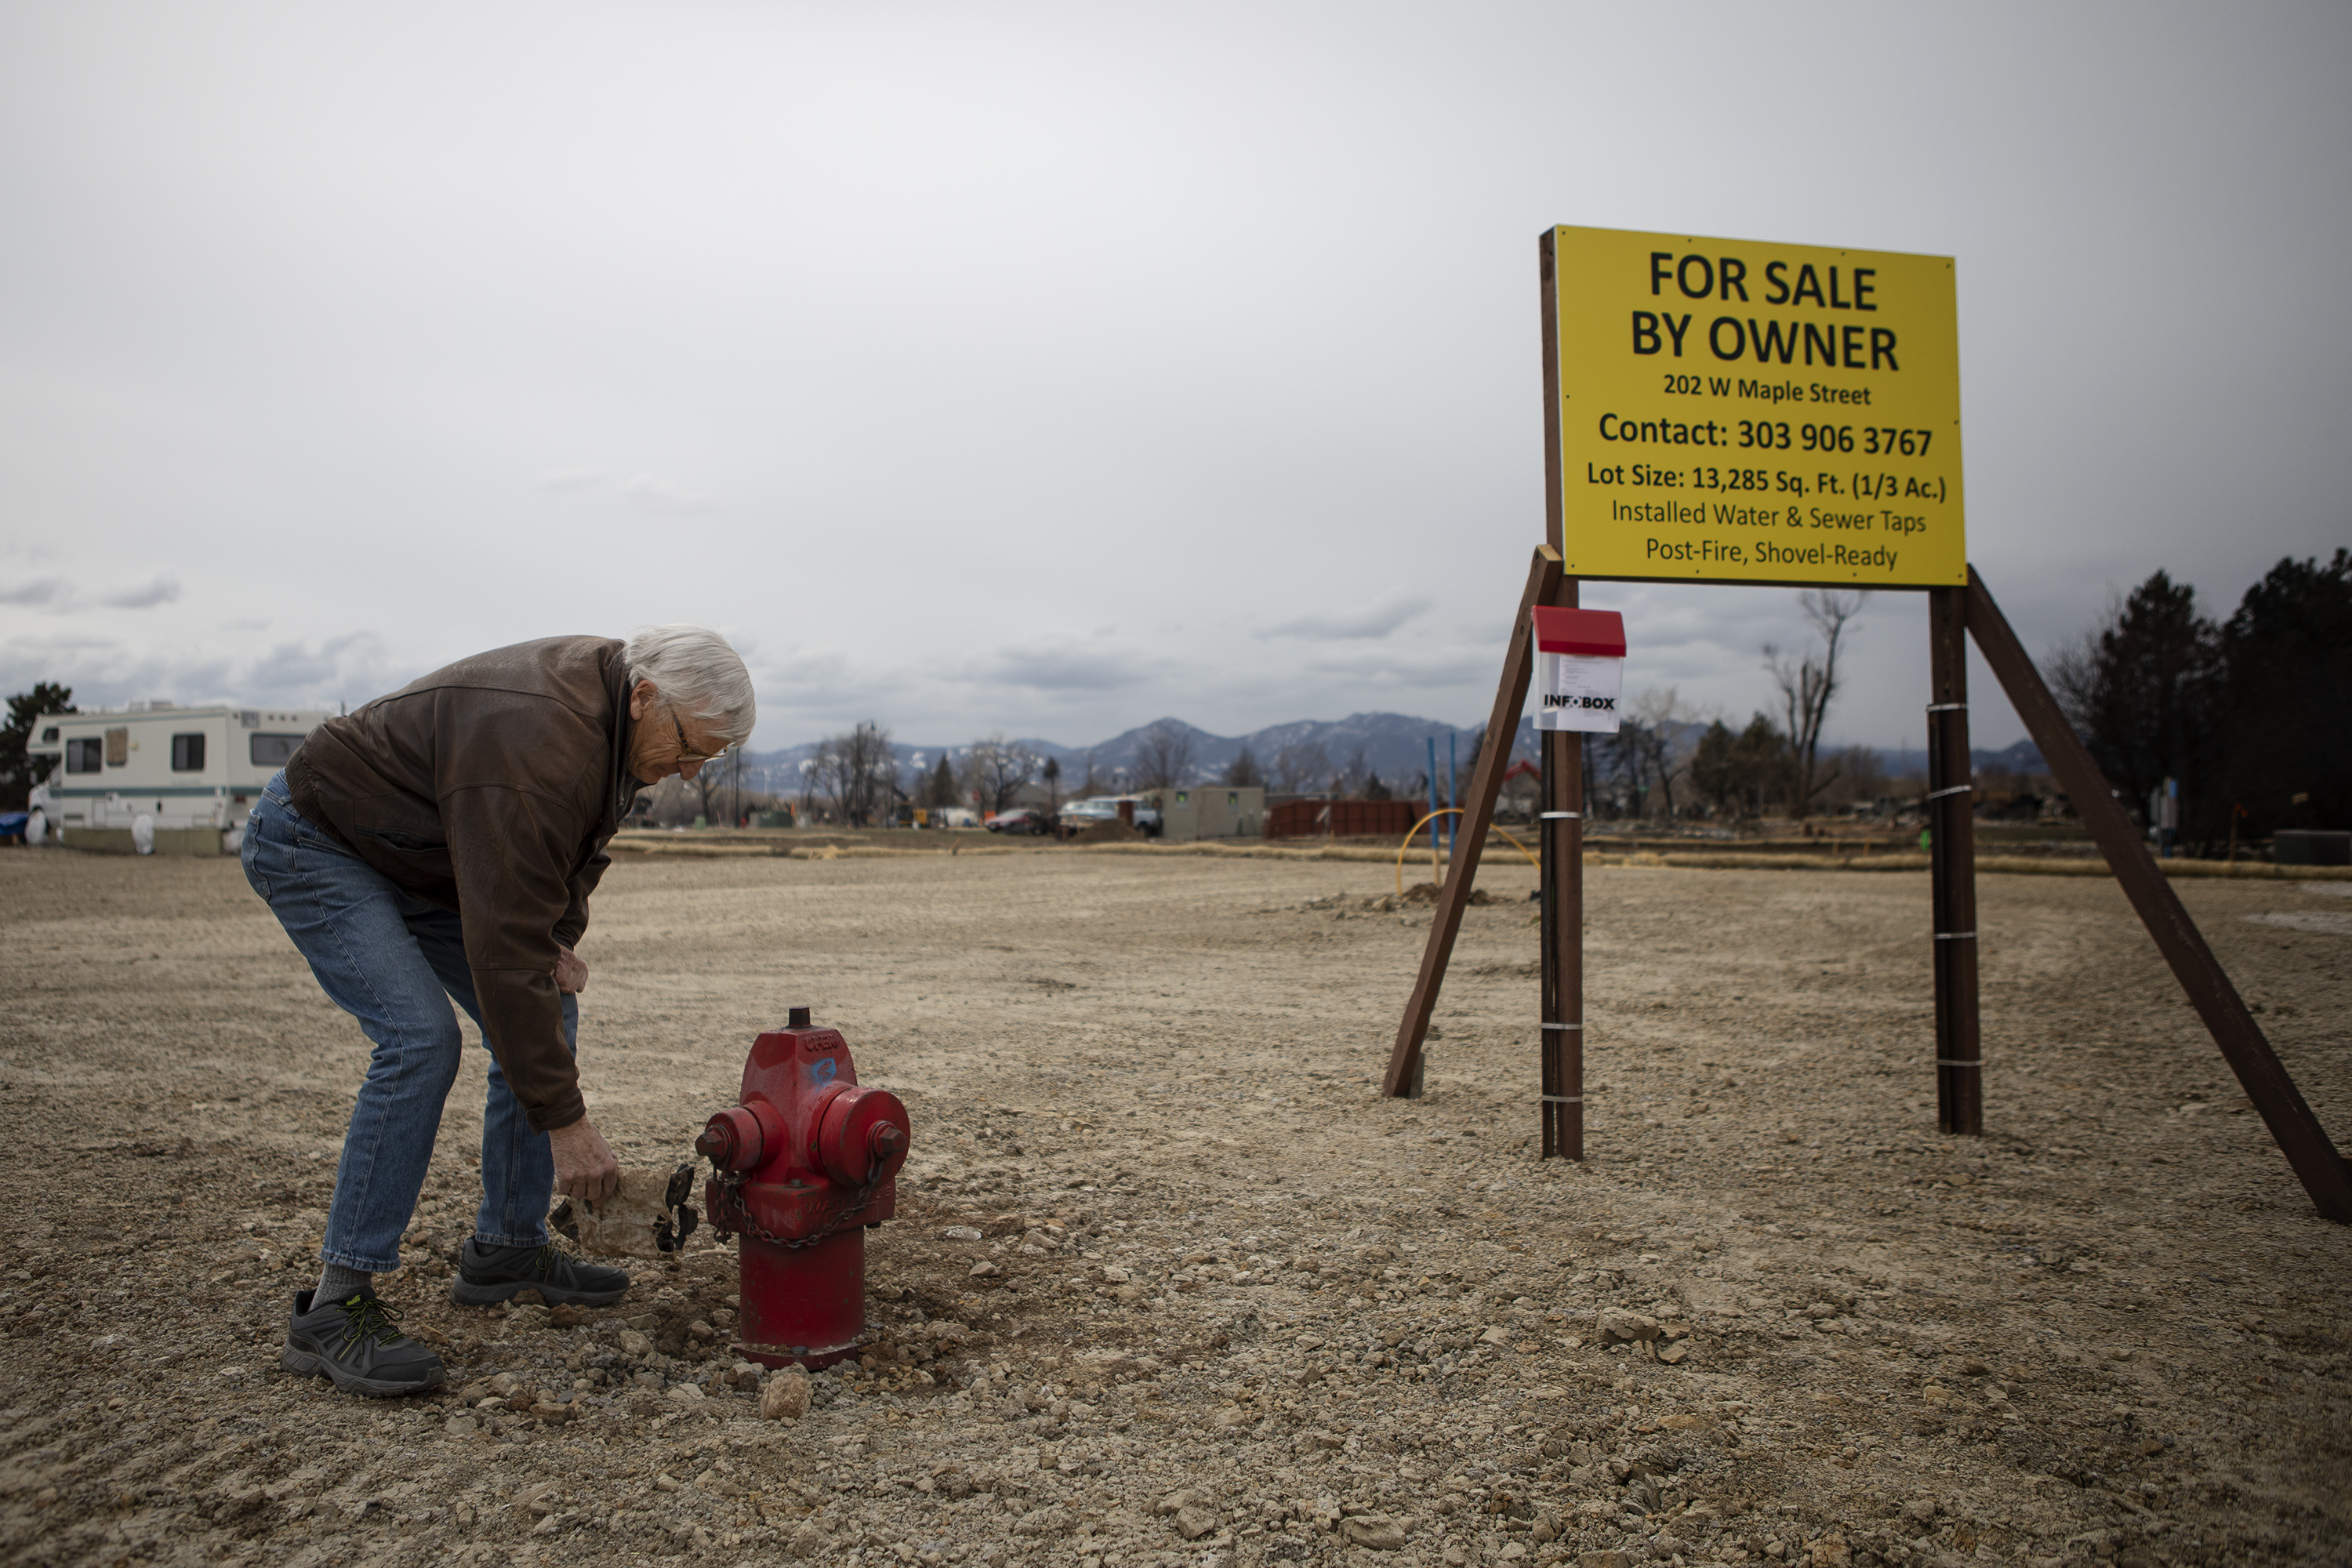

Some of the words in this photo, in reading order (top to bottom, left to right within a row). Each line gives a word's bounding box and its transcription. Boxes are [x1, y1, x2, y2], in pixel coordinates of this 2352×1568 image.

[1650, 251, 1750, 303] FOR
[1765, 260, 1878, 312] SALE
[1632, 310, 1693, 358] BY
[1708, 315, 1900, 372] OWNER
[1664, 373, 1703, 396] 202
[1708, 376, 1732, 397] W
[1738, 378, 1804, 405] Maple
[1809, 382, 1872, 406] Street
[1599, 412, 1729, 447] Contact:
[1738, 419, 1792, 450] 303
[1801, 423, 1855, 453] 906
[1864, 426, 1933, 457] 3767
[1588, 461, 1625, 486] Lot
[1632, 463, 1685, 488] Size:
[1693, 465, 1769, 494] 13,285
[1776, 470, 1810, 499] Sq.
[1817, 472, 1846, 495] Ft.
[1852, 472, 1899, 501] (1/3
[1904, 472, 1947, 504] Ac.)
[1613, 499, 1706, 525] Installed
[1712, 503, 1781, 528] Water
[1786, 505, 1804, 528] &
[1809, 506, 1875, 532] Sewer
[1879, 510, 1927, 537] Taps
[1646, 538, 1748, 566] Post-Fire,
[1755, 540, 1898, 572] Shovel-Ready
